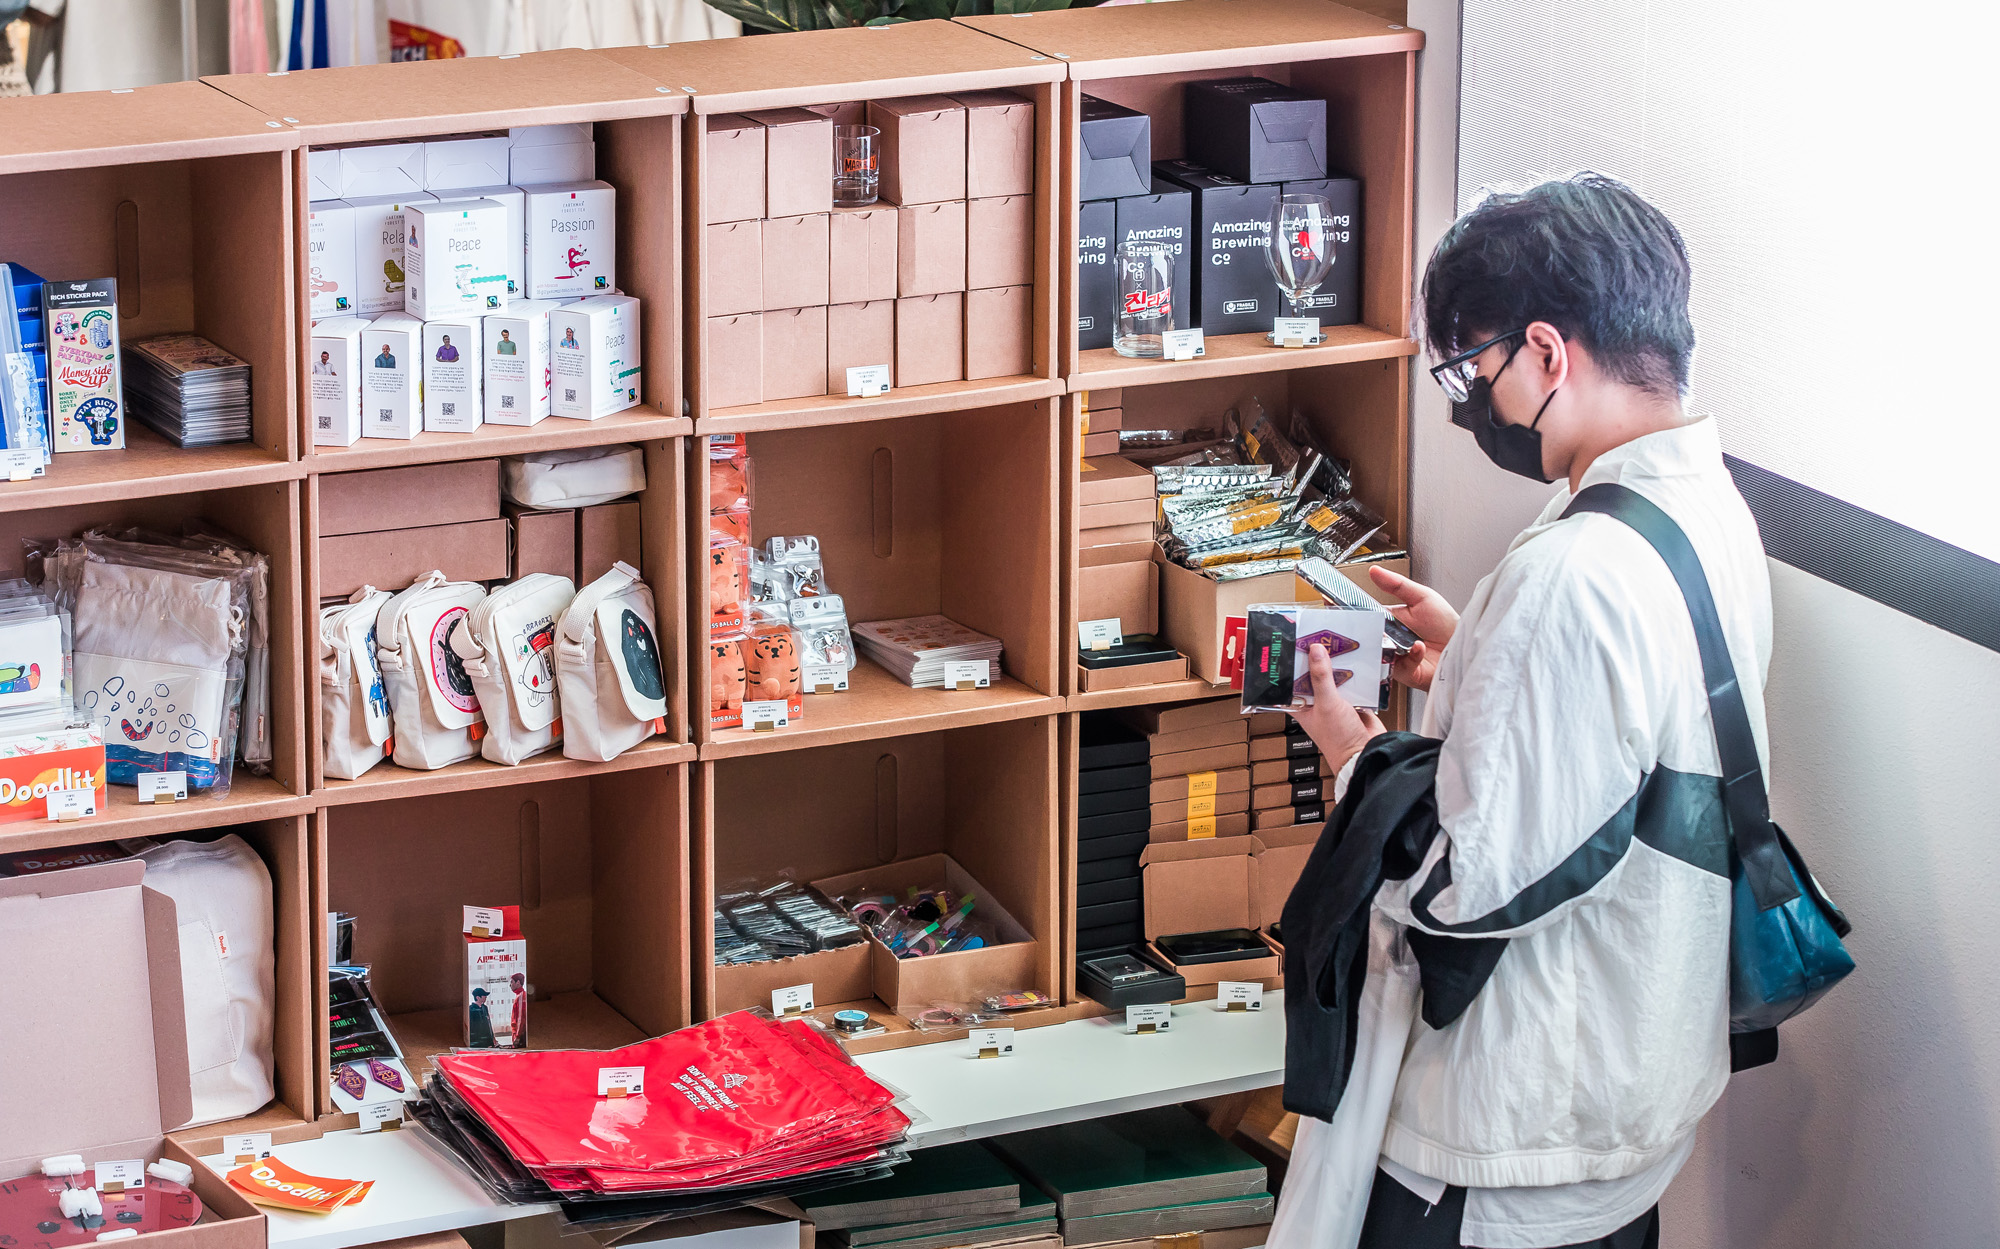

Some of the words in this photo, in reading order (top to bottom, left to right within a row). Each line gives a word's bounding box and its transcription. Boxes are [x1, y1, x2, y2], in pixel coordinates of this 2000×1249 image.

[551, 218, 594, 232] Passion
[1212, 219, 1272, 234] Amazing
[382, 230, 404, 245] Rela
[1080, 235, 1106, 248] zing
[1126, 226, 1182, 242] Amazing
[310, 241, 325, 252] ow
[448, 238, 481, 252] Peace
[1212, 235, 1272, 250] Brewing
[66, 292, 91, 300] STICKER
[1124, 286, 1171, 314] 진라거
[605, 334, 626, 350] Peace
[57, 352, 74, 360] PAY
[74, 356, 92, 365] DAY
[58, 345, 104, 360] EVERYDAY
[58, 366, 91, 382] Money
[92, 365, 112, 376] side
[76, 402, 92, 420] STAY
[94, 400, 116, 410] RICH
[719, 620, 734, 628] BALL
[0, 767, 96, 804] Doodlit
[335, 1043, 359, 1051] WATCHA
[345, 1077, 361, 1085] 211
[379, 1071, 395, 1080] 212
[679, 1074, 699, 1086] DON'T
[693, 1085, 718, 1106] IGNORE
[686, 1064, 707, 1079] DON'T
[700, 1078, 719, 1090] HIDE
[712, 1088, 734, 1105] FROM
[670, 1082, 690, 1092] JUST
[683, 1090, 701, 1106] FEEL
[250, 1166, 332, 1201] Doodlit
